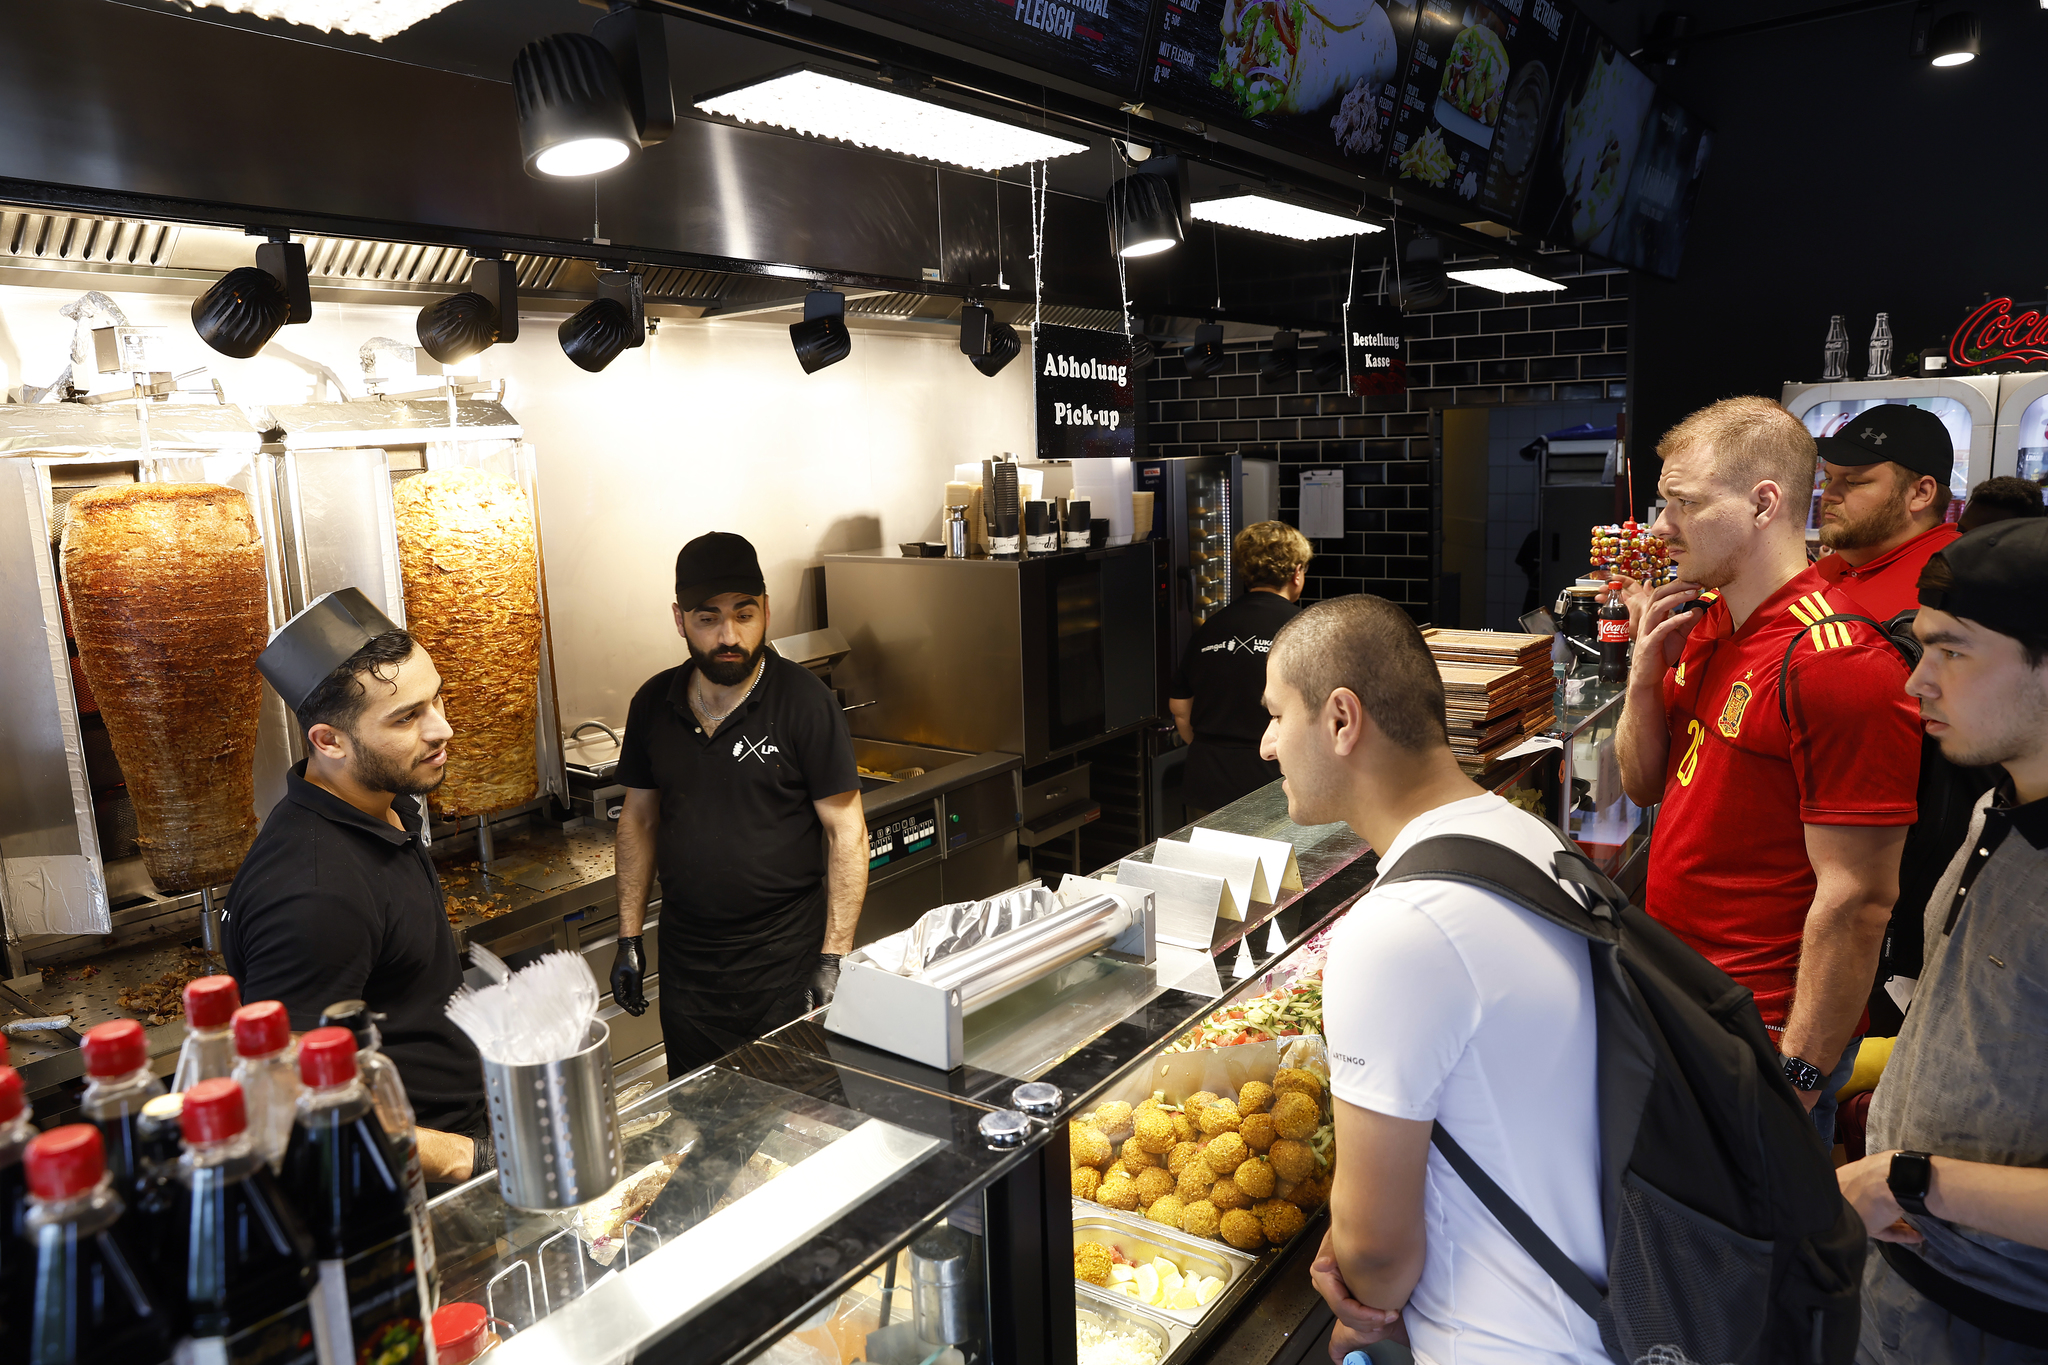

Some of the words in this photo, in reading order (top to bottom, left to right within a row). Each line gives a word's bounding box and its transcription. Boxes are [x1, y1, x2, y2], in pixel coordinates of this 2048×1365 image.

[1015, 0, 1075, 40] FLEISCH
[1158, 41, 1171, 58] MIT
[1171, 45, 1195, 67] FLEISCH
[1352, 331, 1400, 350] Bestellung
[1043, 352, 1128, 387] Abholung
[1364, 353, 1391, 369] Kasse
[1054, 402, 1121, 431] Pick-up
[1603, 621, 1630, 635] Coca-Co
